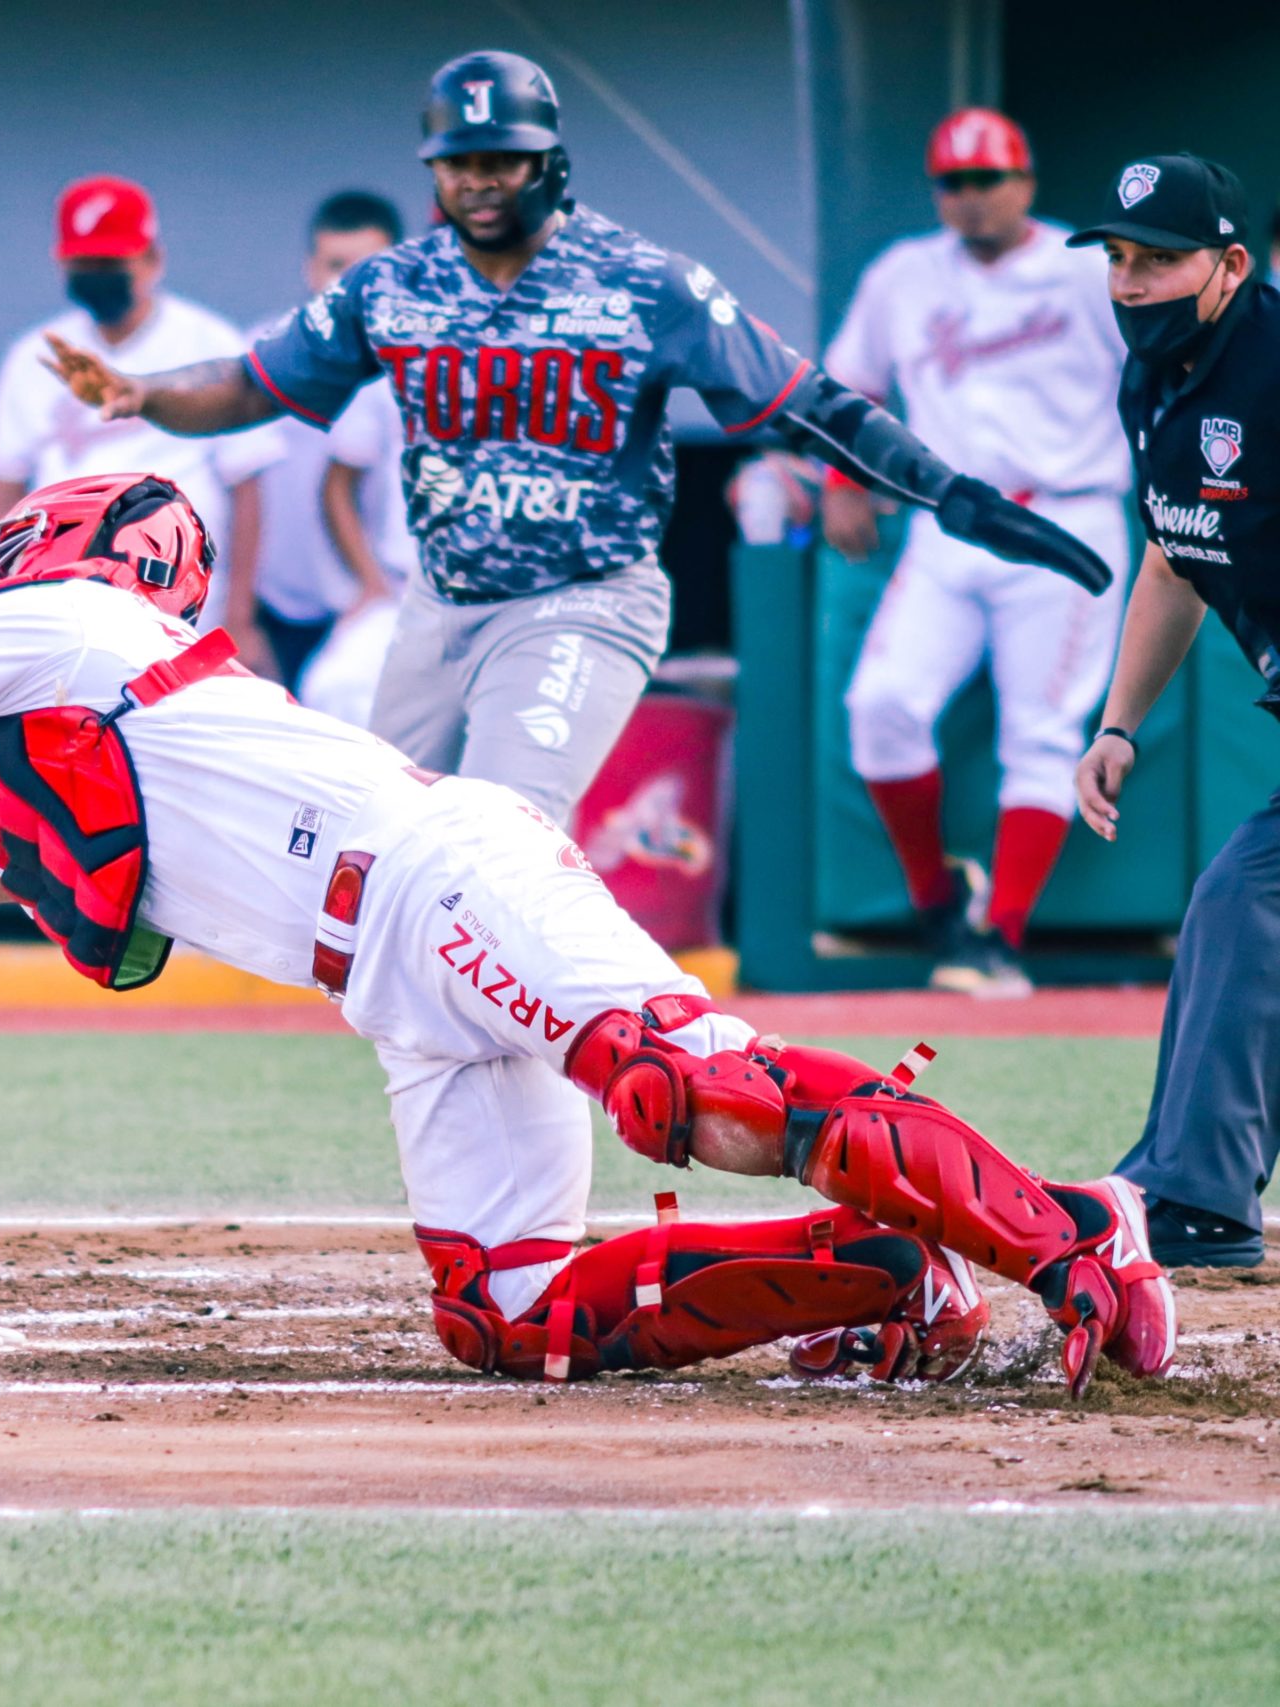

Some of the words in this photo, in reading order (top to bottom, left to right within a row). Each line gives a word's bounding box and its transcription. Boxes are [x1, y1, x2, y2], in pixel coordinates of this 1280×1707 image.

[462, 80, 494, 125] J
[552, 313, 628, 336] Havoline
[378, 345, 625, 454] TOROS
[1201, 418, 1242, 443] LMB
[463, 472, 593, 522] AT&T
[538, 634, 583, 703] BAJA
[300, 808, 311, 826] NEW
[308, 810, 319, 829] ERA
[461, 909, 502, 950] METALS
[438, 922, 576, 1042] ARZYZ
